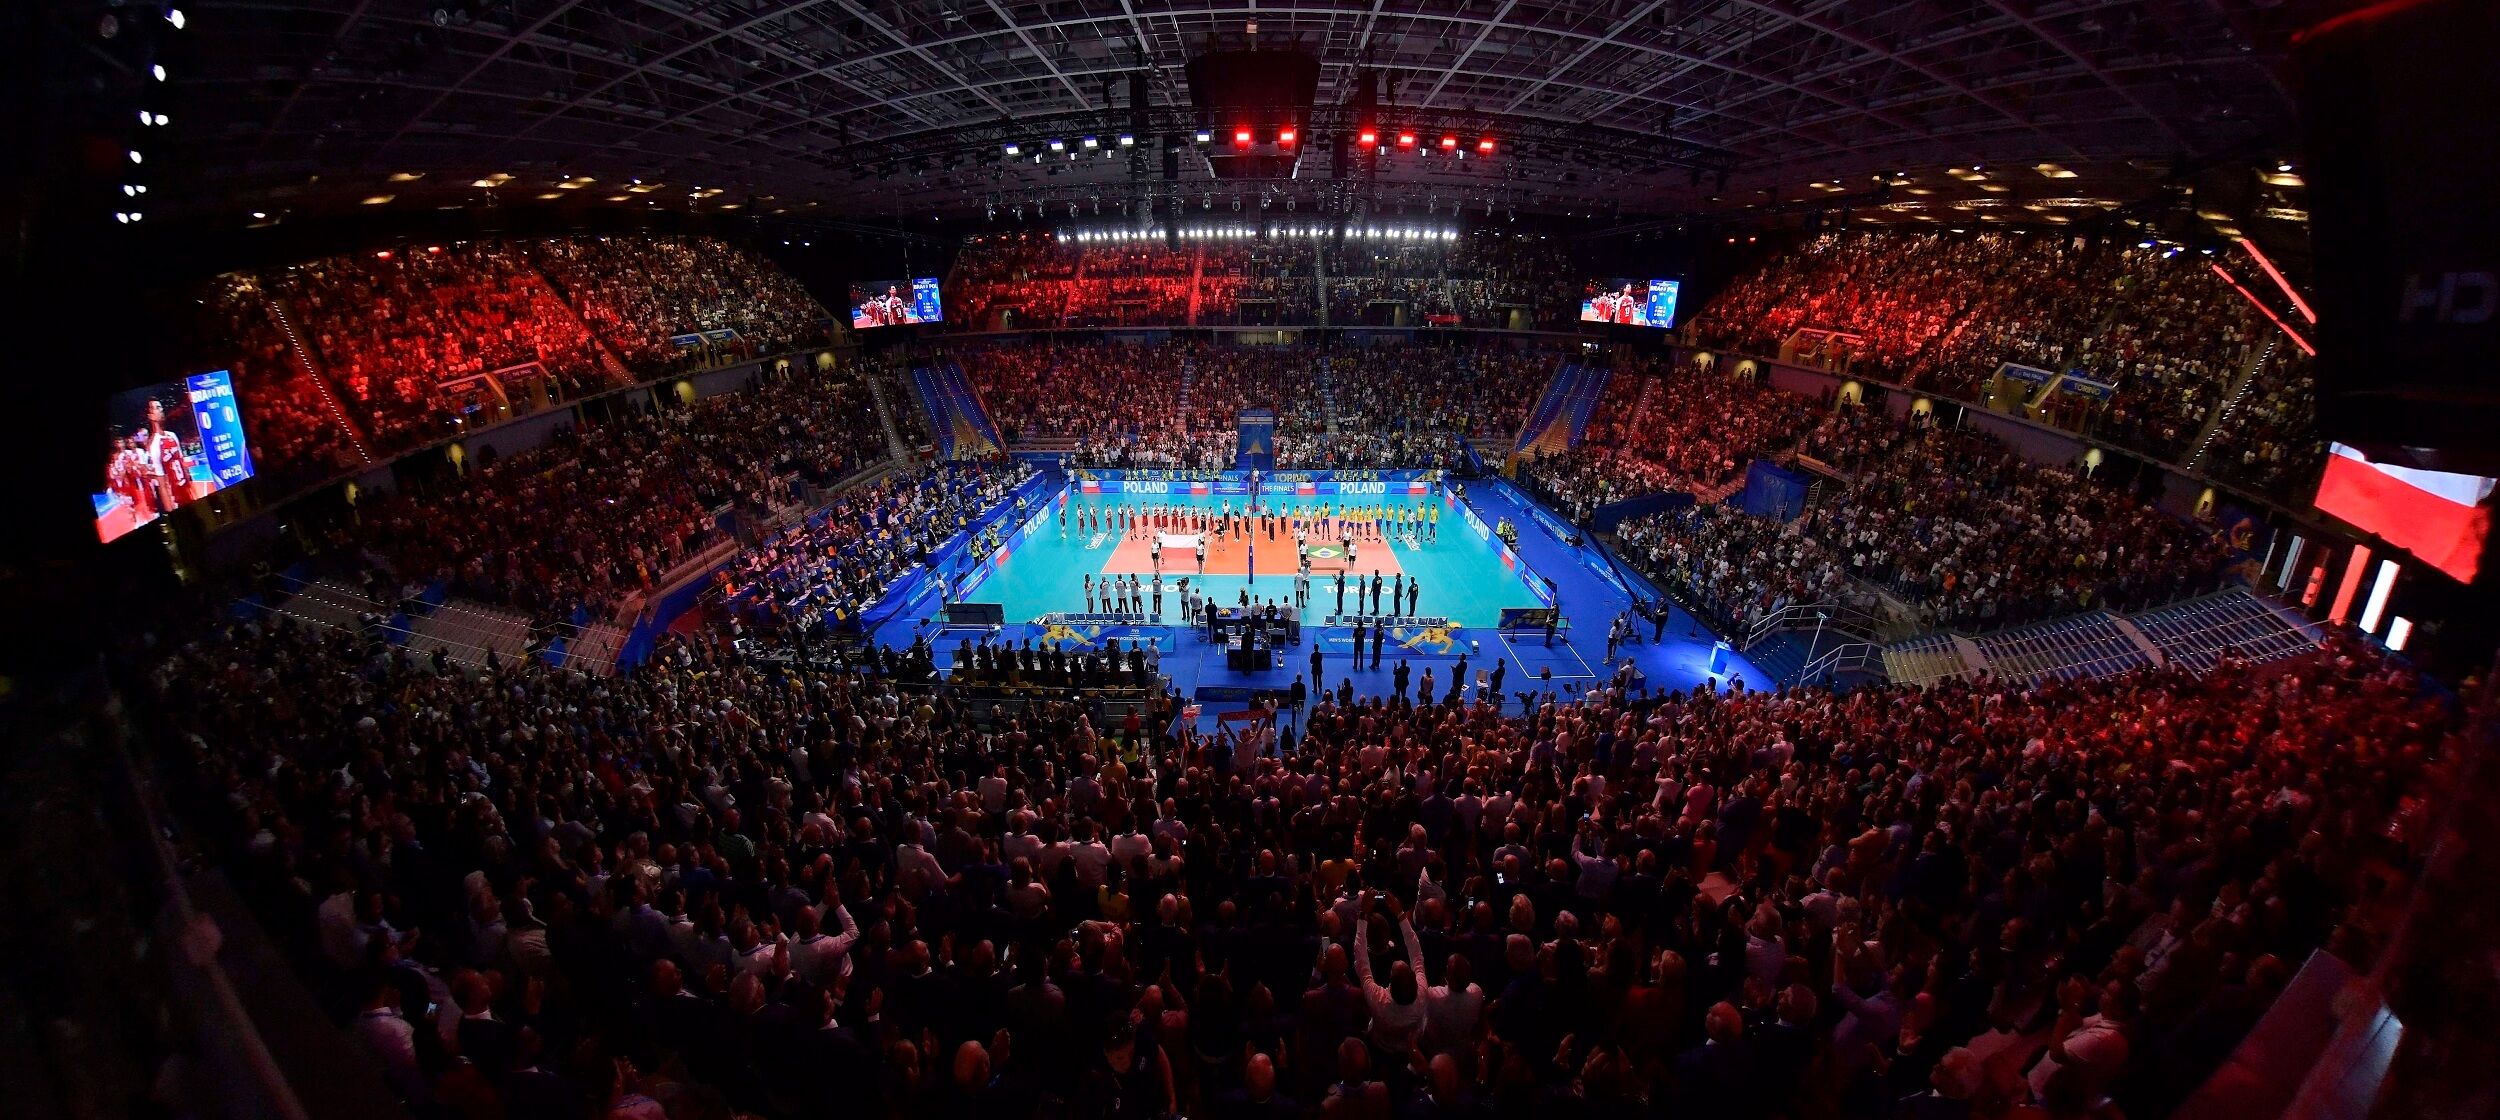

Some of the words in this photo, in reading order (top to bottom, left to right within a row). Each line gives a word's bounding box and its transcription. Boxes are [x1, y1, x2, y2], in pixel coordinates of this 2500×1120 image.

[189, 389, 210, 404] BRA
[215, 384, 234, 398] POL
[449, 381, 476, 394] TORINO
[2075, 383, 2102, 396] TORINO
[199, 411, 212, 430] 0
[223, 405, 236, 423] 0
[220, 464, 243, 480] 04:29
[1273, 473, 1312, 482] TORINO
[1123, 481, 1169, 494] POLAND
[1340, 481, 1386, 494] POLAND
[1023, 505, 1050, 540] POLAND
[1464, 506, 1490, 541] POLAND
[1112, 584, 1179, 593] TRIO
[1323, 585, 1394, 595] TORNO
